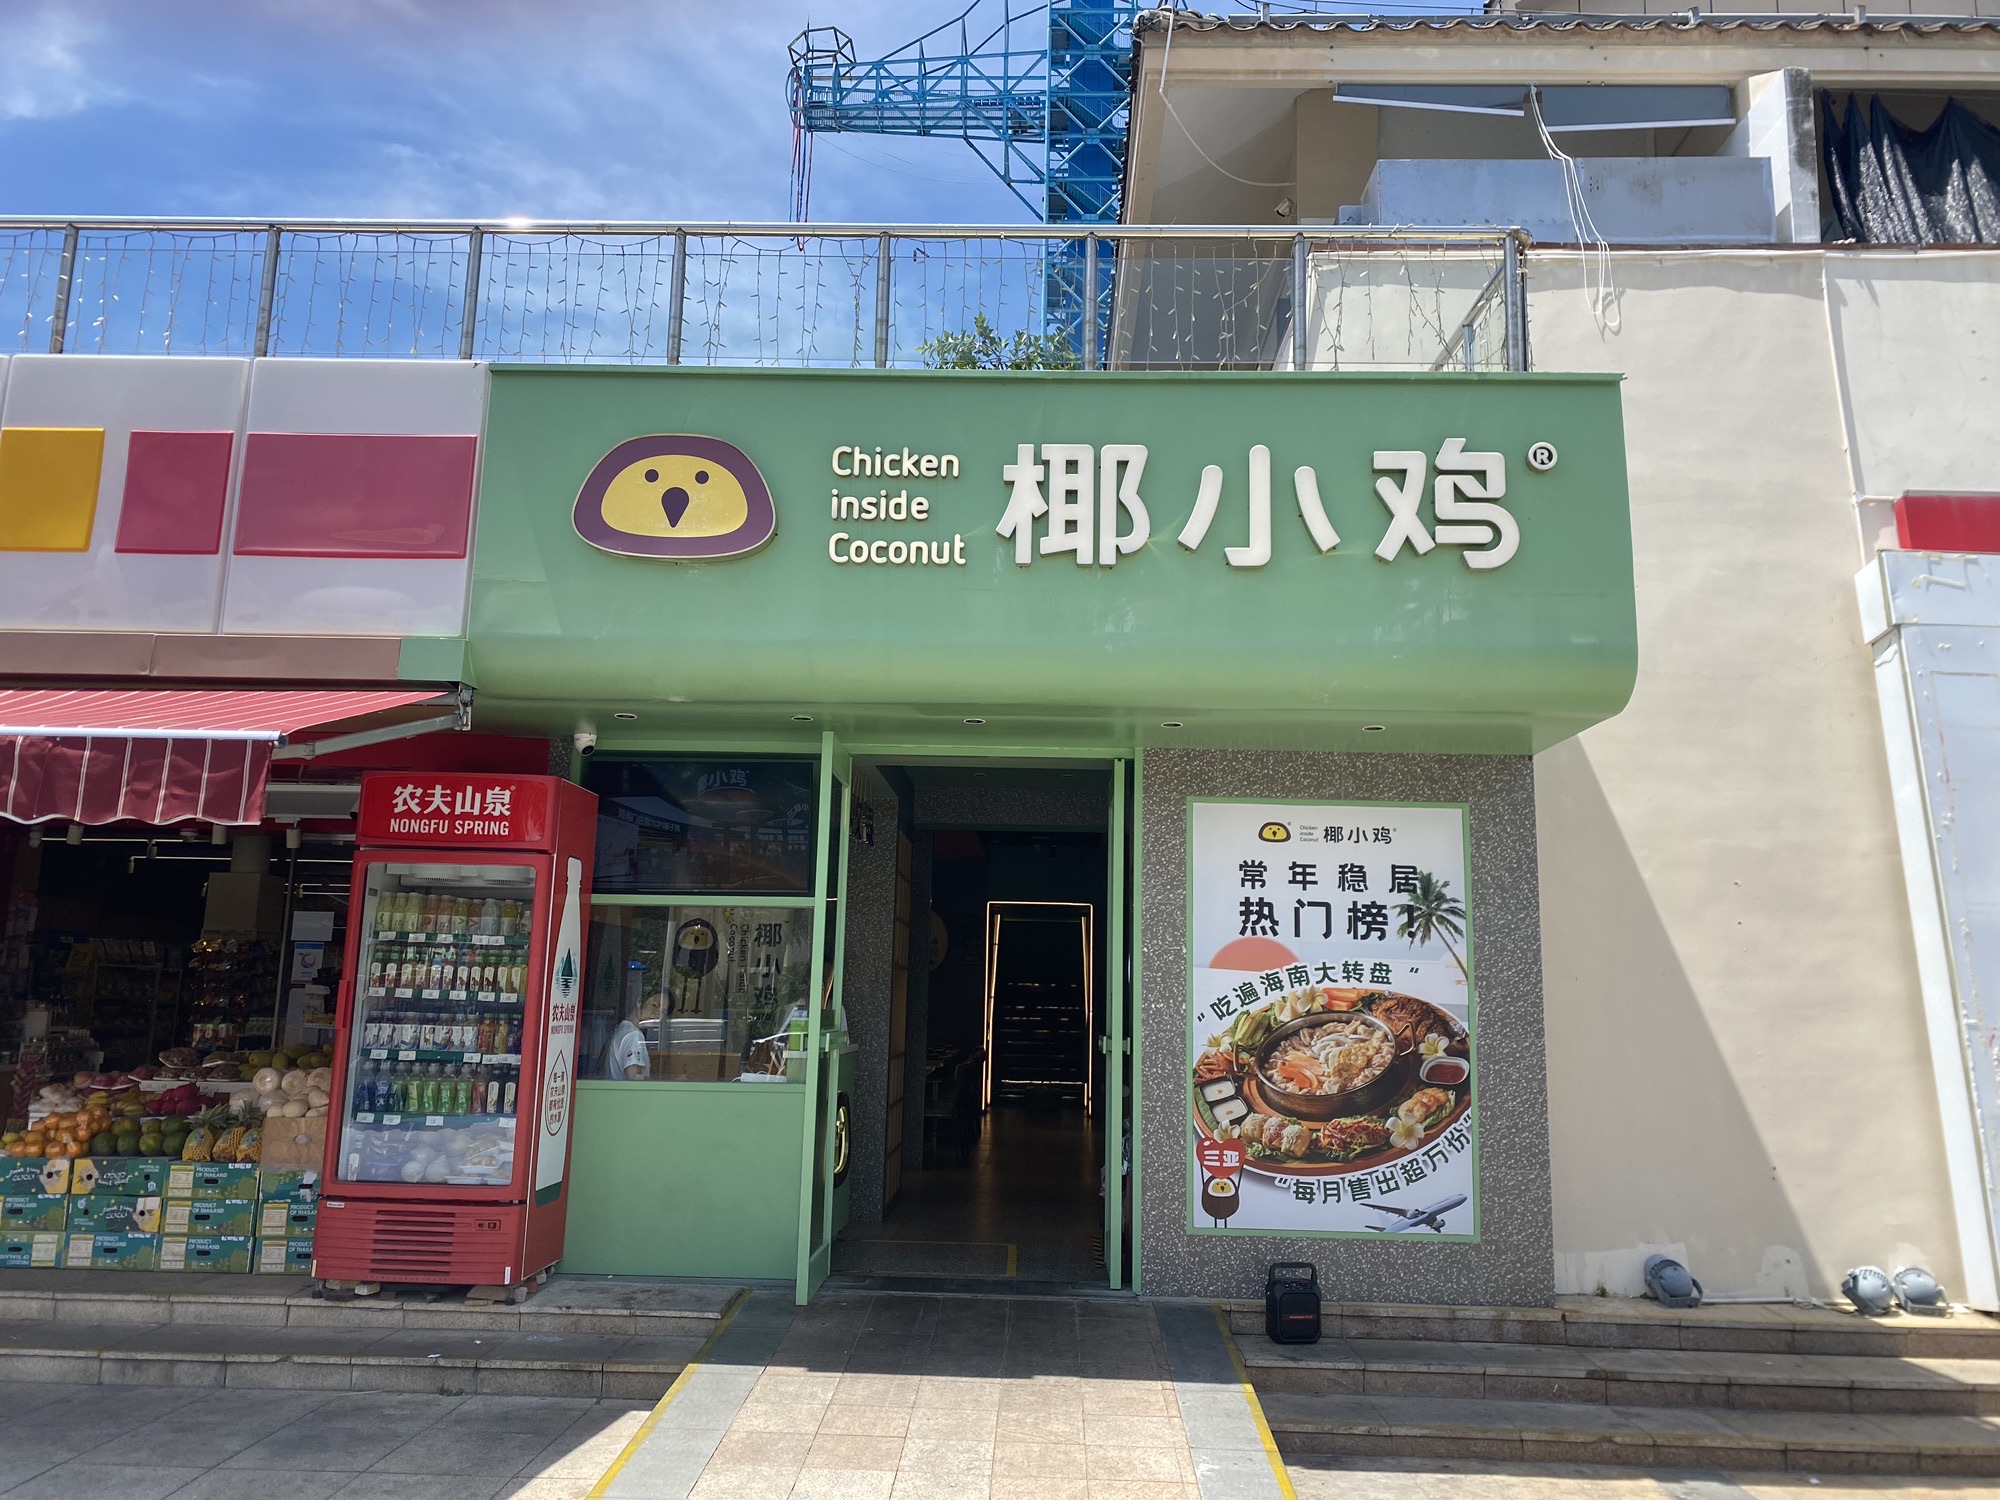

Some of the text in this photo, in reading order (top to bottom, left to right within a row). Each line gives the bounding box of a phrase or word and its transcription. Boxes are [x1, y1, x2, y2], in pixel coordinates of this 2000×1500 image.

[831, 445, 960, 479] Chicken
[830, 488, 930, 521] inside
[995, 437, 1521, 570] 椰小鸡
[828, 530, 967, 565] Coconut
[391, 783, 512, 817] 农夫山泉
[389, 818, 510, 836] NONGFU SPRING
[1323, 825, 1393, 845] 椰小鸡
[1237, 859, 1419, 895] 常年稳居
[551, 1003, 577, 1023] 农夫山泉
[1203, 1149, 1240, 1167] 三亚
